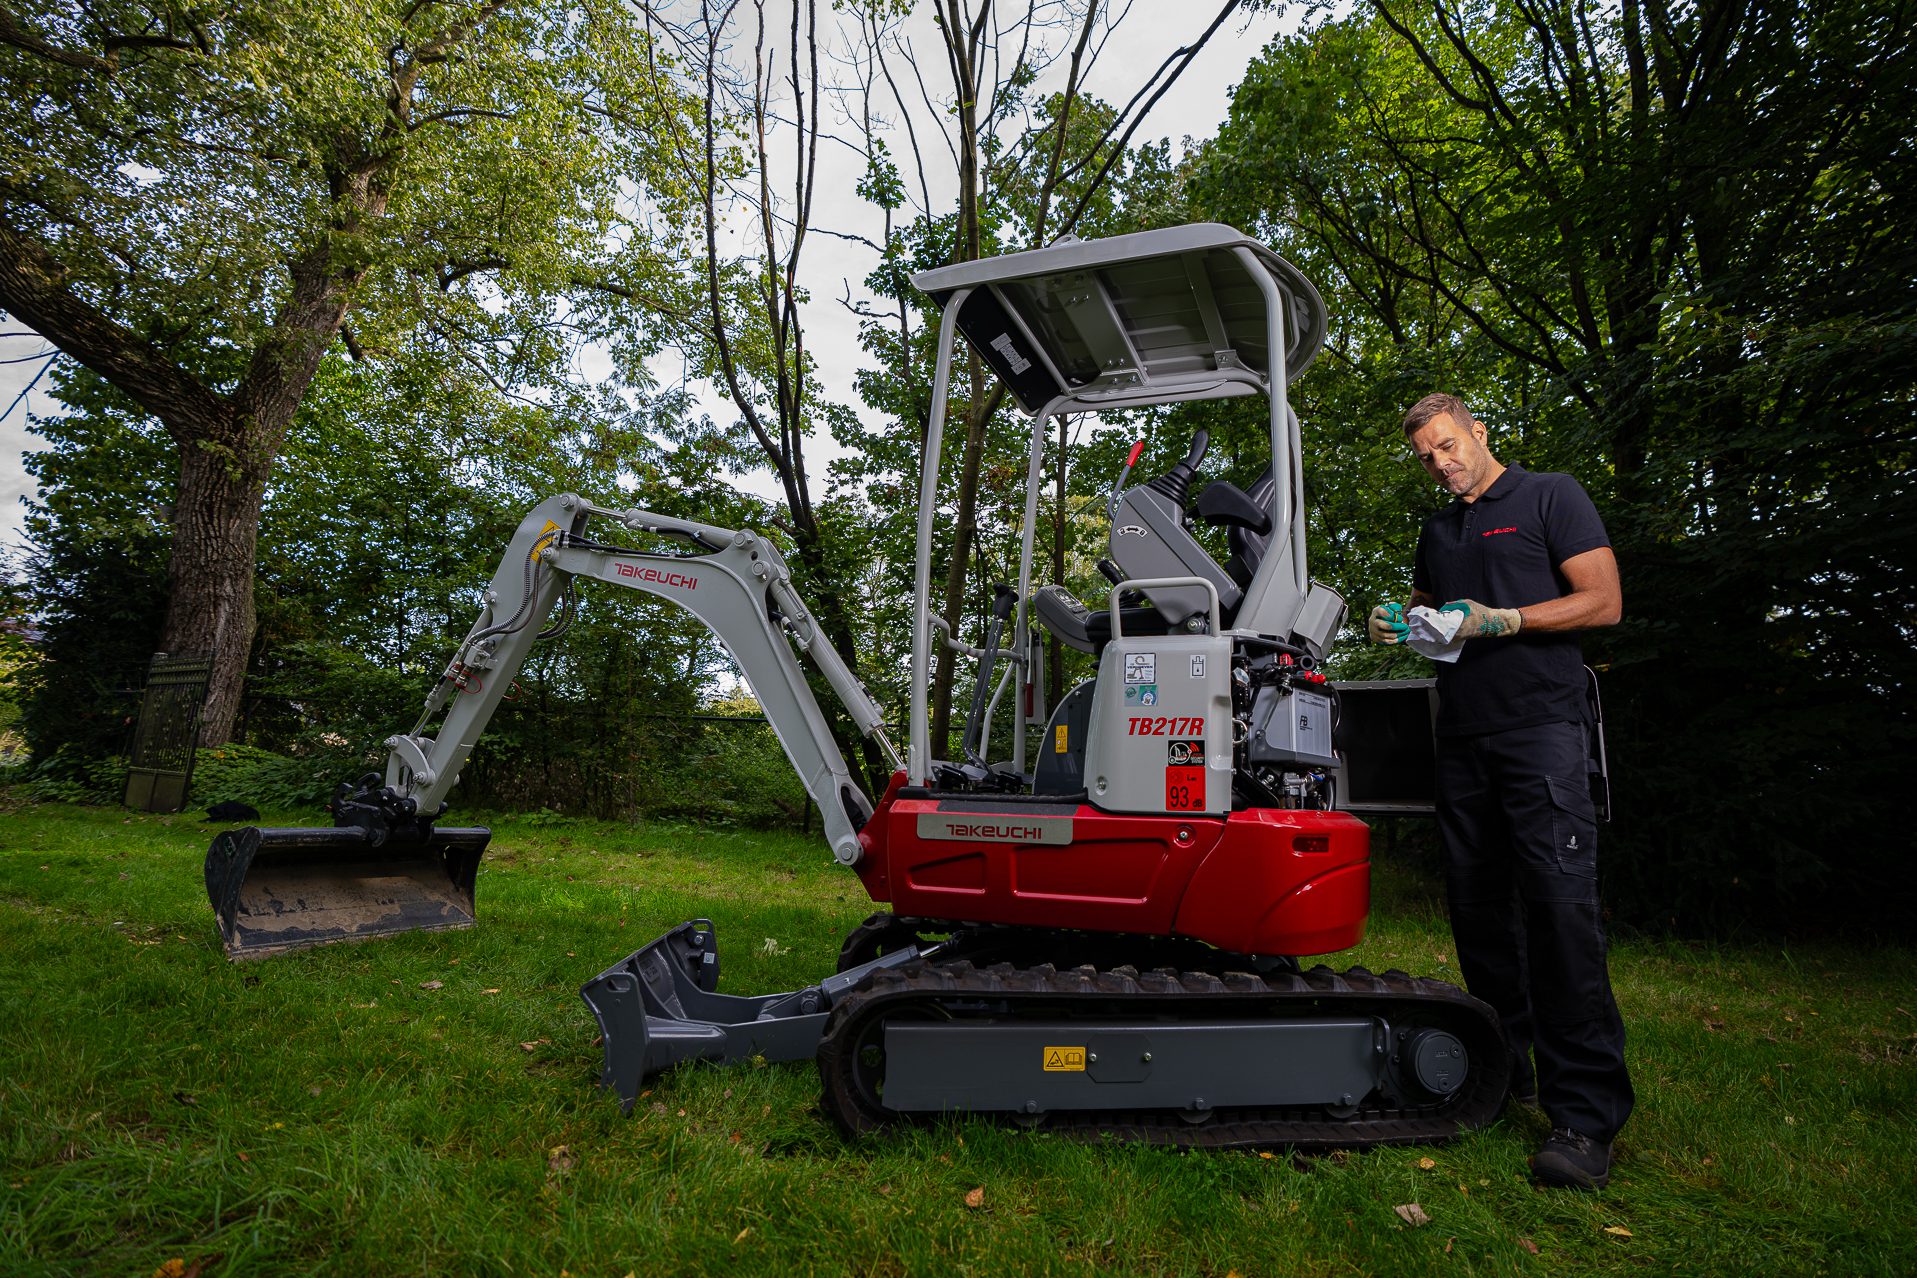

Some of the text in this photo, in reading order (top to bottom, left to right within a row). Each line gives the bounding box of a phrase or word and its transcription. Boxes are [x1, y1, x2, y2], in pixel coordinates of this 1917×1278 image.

[615, 562, 698, 590] TAKEUCHI
[1128, 717, 1205, 736] TB217R
[1170, 786, 1203, 808] 93 dB
[946, 824, 1042, 840] TAKEUCHI
